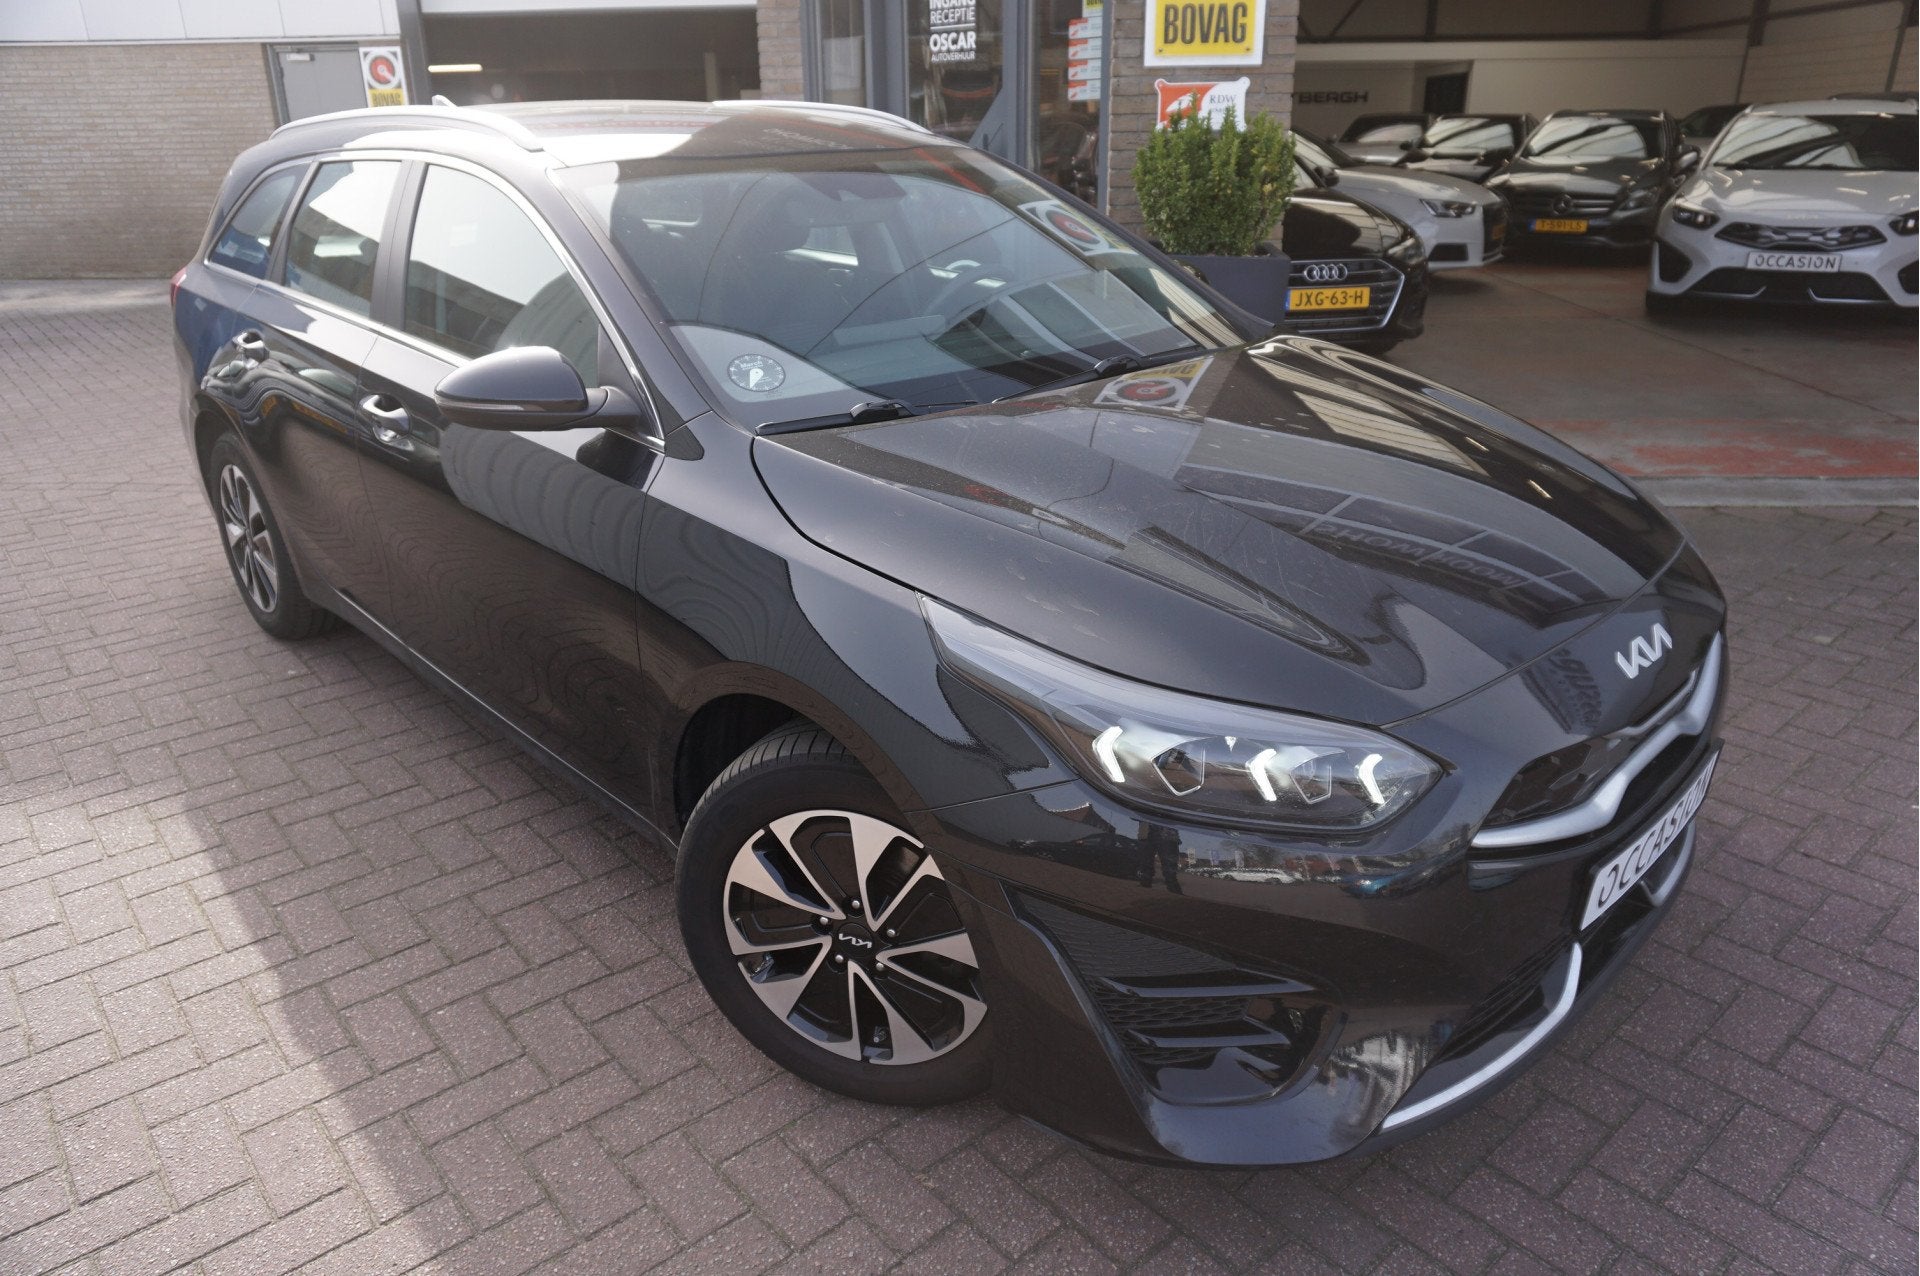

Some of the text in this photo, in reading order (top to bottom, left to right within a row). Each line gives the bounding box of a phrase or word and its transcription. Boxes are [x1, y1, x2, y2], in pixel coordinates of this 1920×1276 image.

[930, 6, 976, 24] RECEPTIE
[1163, 3, 1248, 44] BOVAG
[929, 31, 977, 52] OSCAR
[931, 51, 975, 61] AUTOVERHUUR
[1208, 94, 1237, 105] RDW
[1291, 91, 1369, 104] BERGH
[1754, 254, 1837, 269] OCCASION
[1295, 290, 1364, 307] JXG-63-H
